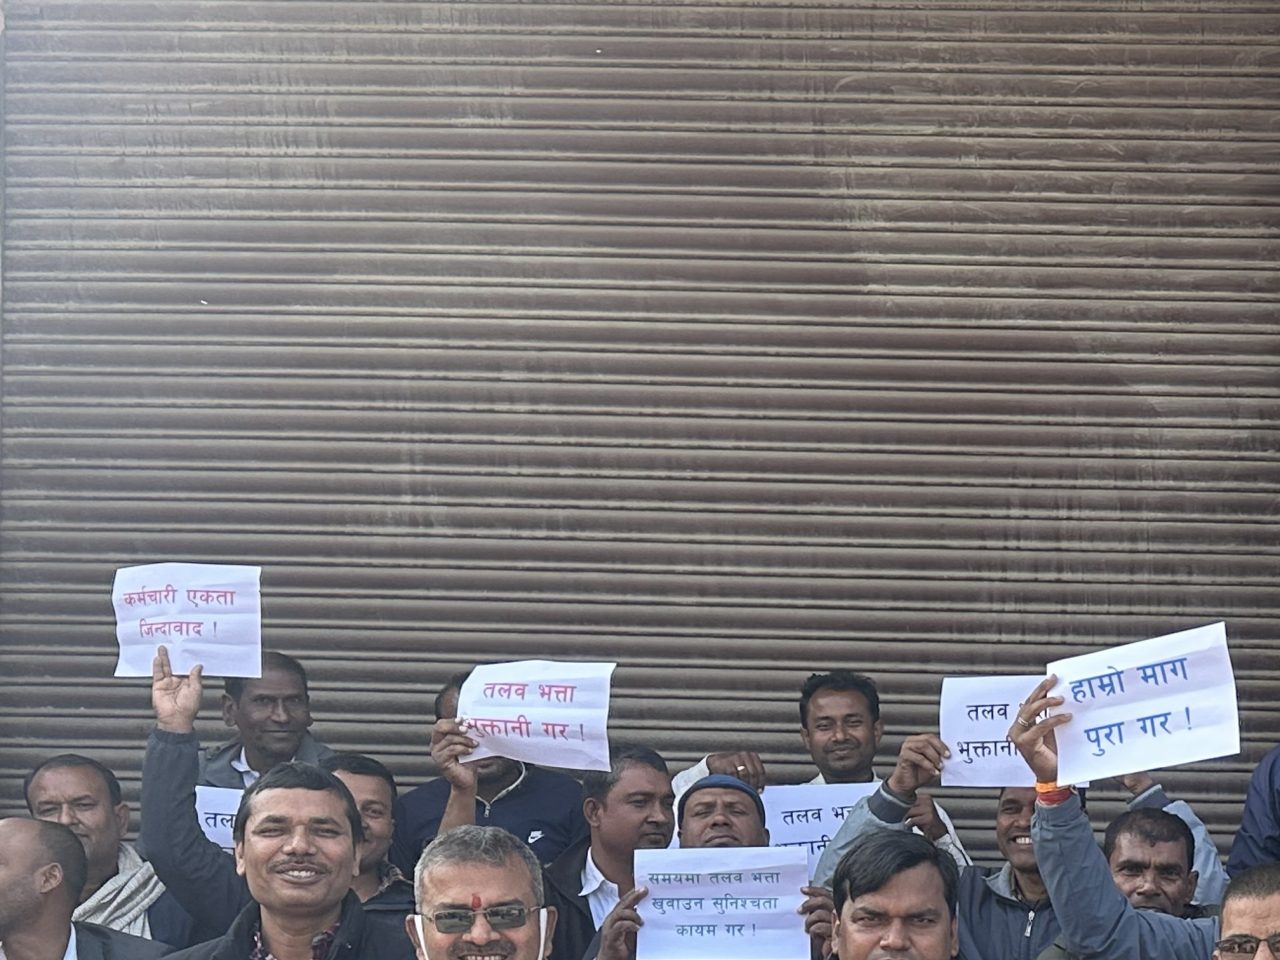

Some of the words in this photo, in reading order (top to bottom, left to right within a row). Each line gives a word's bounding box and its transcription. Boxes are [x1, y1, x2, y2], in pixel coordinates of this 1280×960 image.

[123, 583, 179, 608] कर्मचारी
[186, 589, 235, 608] एकता
[139, 618, 204, 638] जिन्दावाद
[1069, 665, 1125, 704] हाम्रो
[1135, 657, 1188, 686] माग
[482, 682, 530, 701] तलव
[538, 684, 578, 704] भत्ता
[966, 703, 1010, 721] तलव
[541, 722, 570, 741] गर
[1083, 721, 1125, 757] पुरा
[1135, 711, 1172, 738] गर
[203, 811, 237, 828] तल
[780, 807, 823, 826] तलव
[647, 872, 703, 886] समयमा
[707, 872, 744, 884] तलव
[750, 872, 781, 884] भत्ता
[675, 924, 718, 937] कायम
[724, 923, 746, 937] गर
